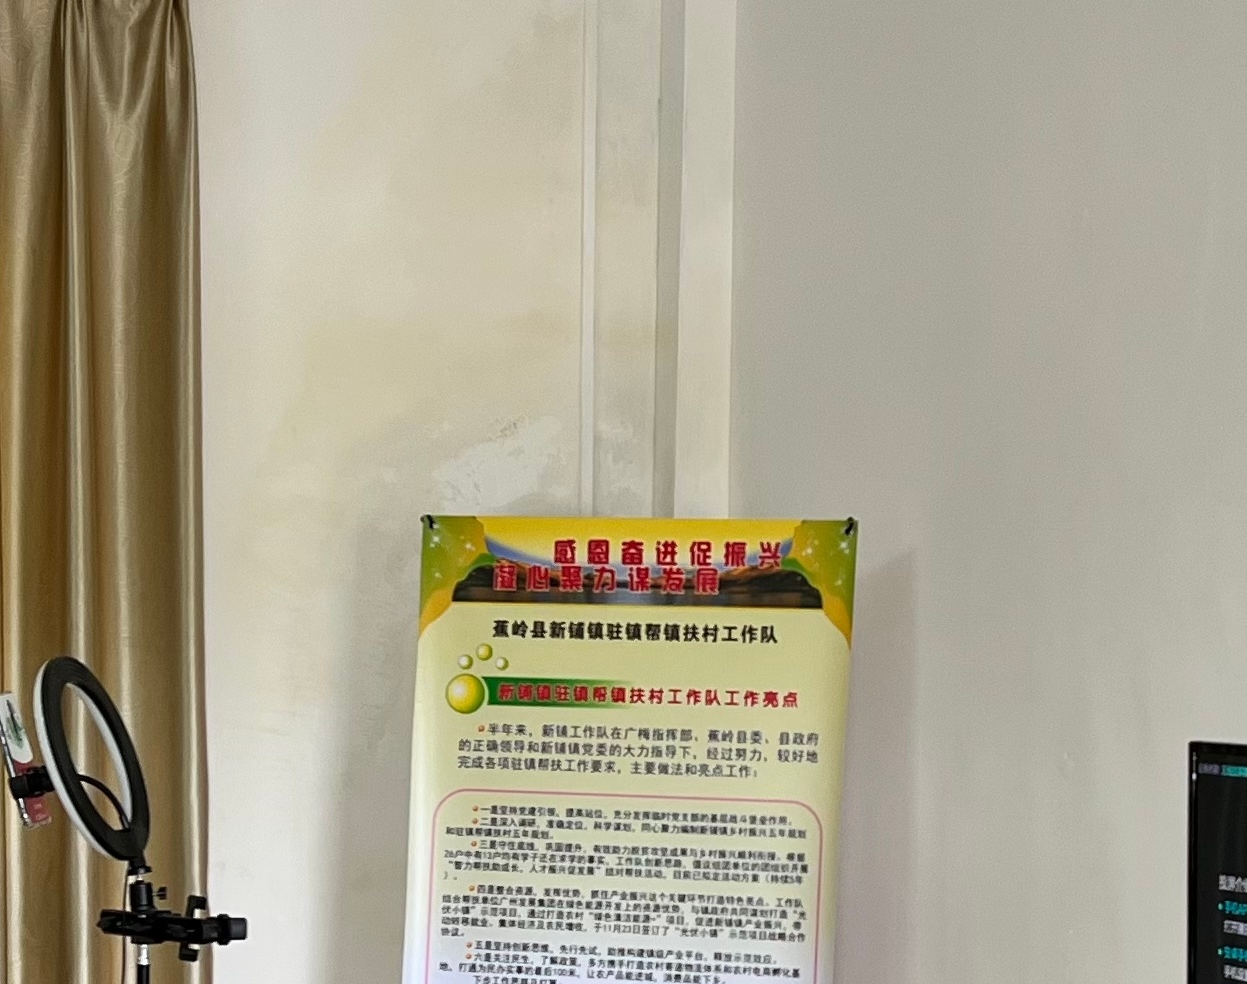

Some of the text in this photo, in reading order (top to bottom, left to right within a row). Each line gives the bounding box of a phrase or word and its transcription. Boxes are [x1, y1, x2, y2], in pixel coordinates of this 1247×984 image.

[554, 539, 782, 569] 感恩奋进促振兴
[492, 564, 720, 594] 凝心聚力谋发展
[492, 620, 779, 645] 蕉岭县新铺镇驻镇帮镇扶村工作队
[498, 682, 799, 709] 新铺镇驻镇帮镇扶村工作队工作亮点
